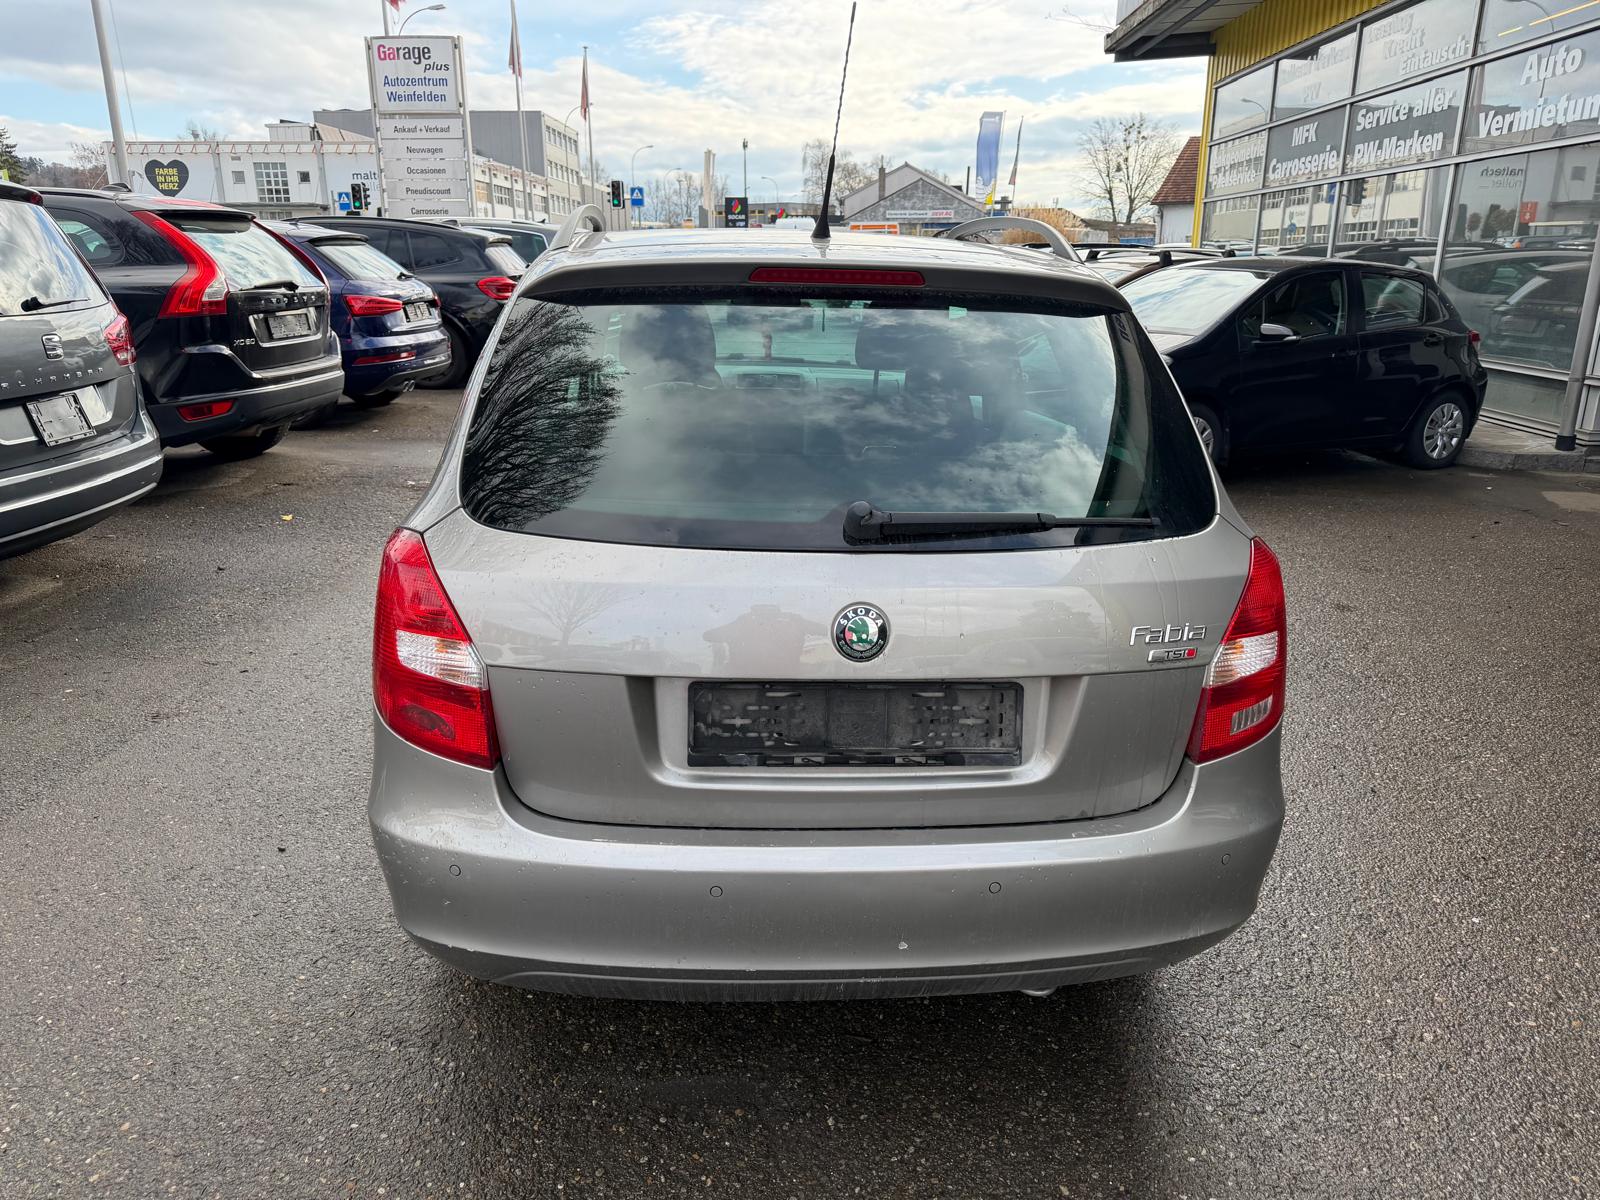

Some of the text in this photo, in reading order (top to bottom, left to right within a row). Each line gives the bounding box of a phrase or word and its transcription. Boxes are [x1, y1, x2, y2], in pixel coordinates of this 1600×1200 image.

[377, 44, 431, 65] Garage
[1401, 33, 1471, 75] Eintausch-
[423, 61, 450, 73] plus
[1520, 44, 1583, 86] Auto
[383, 75, 448, 87] Autozentrum
[386, 91, 447, 103] Weinfelden
[1355, 87, 1454, 132] Service aller
[1479, 93, 1600, 139] Vermietun
[393, 125, 418, 134] Ankauf
[424, 125, 450, 133] Verkauf
[1291, 122, 1319, 147] MFK
[406, 146, 443, 155] Neuwagen
[1353, 130, 1443, 166] PW-Marken
[1268, 145, 1338, 180] Carrosserie
[352, 171, 377, 180] malt
[406, 166, 446, 175] Occasionen
[166, 175, 179, 183] IHR
[405, 187, 451, 195] Pneudiscount
[410, 207, 449, 216] Carrosserie
[1129, 622, 1207, 646] Fabia
[1164, 649, 1187, 660] TSI
